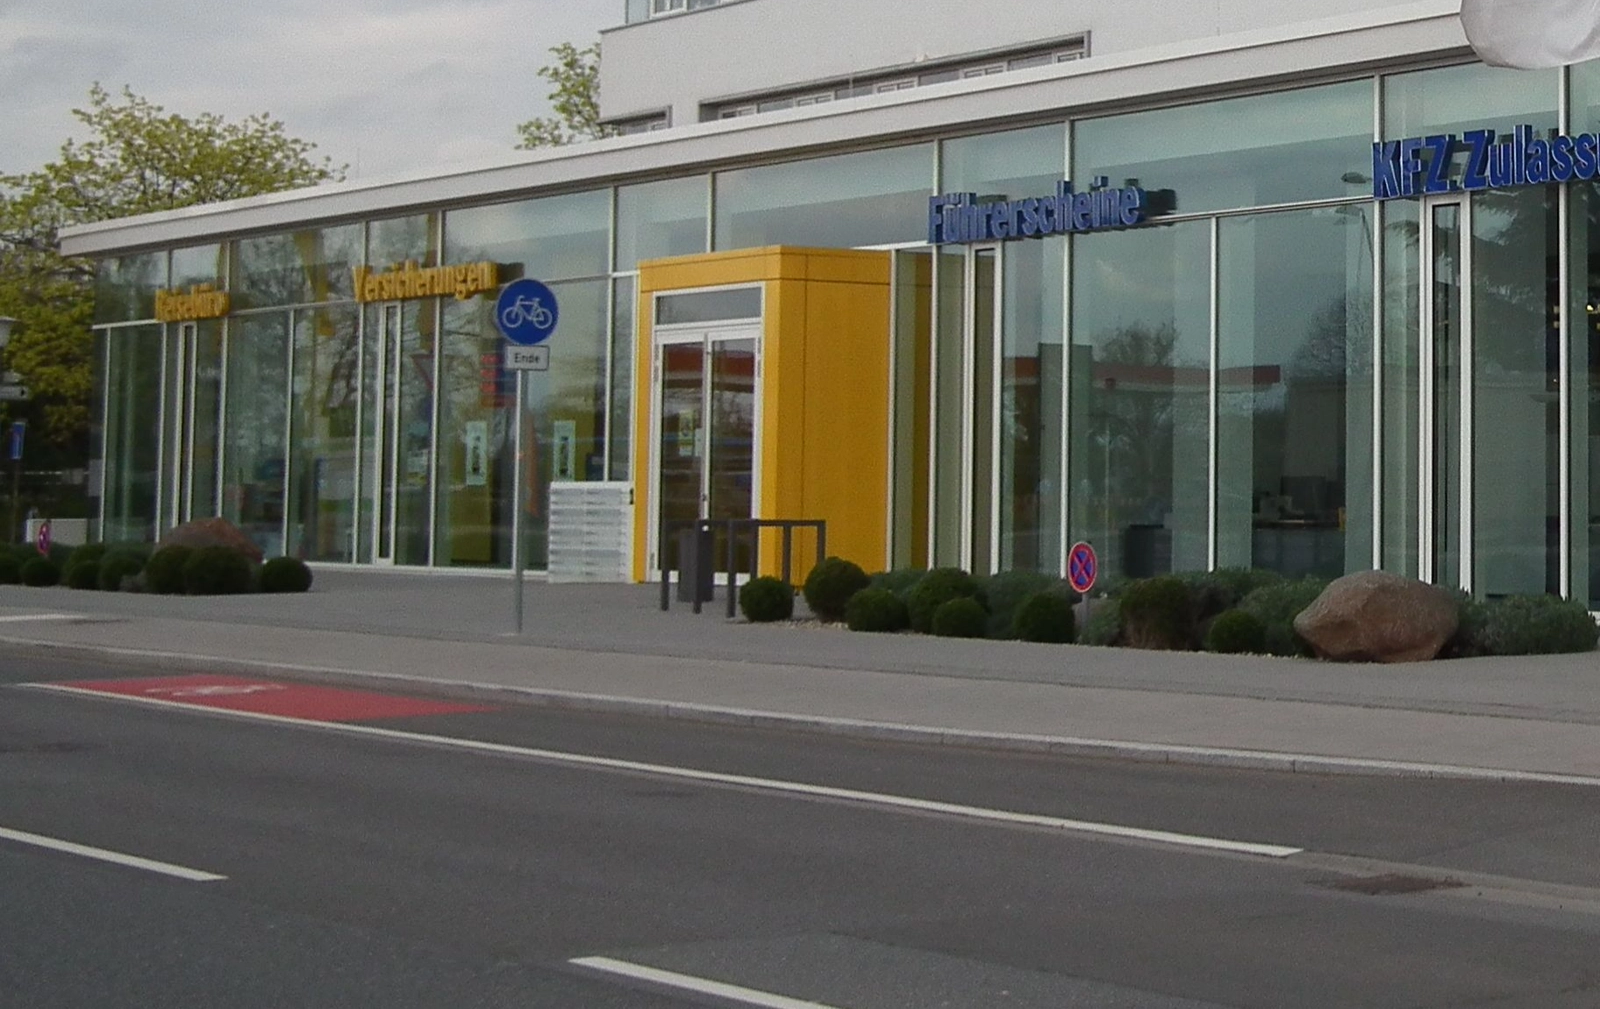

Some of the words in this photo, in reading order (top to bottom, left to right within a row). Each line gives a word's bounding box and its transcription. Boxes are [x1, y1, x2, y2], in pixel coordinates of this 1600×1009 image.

[928, 175, 1143, 244] Führerscheine
[353, 259, 496, 303] Versicherungen
[514, 352, 539, 364] Ende
